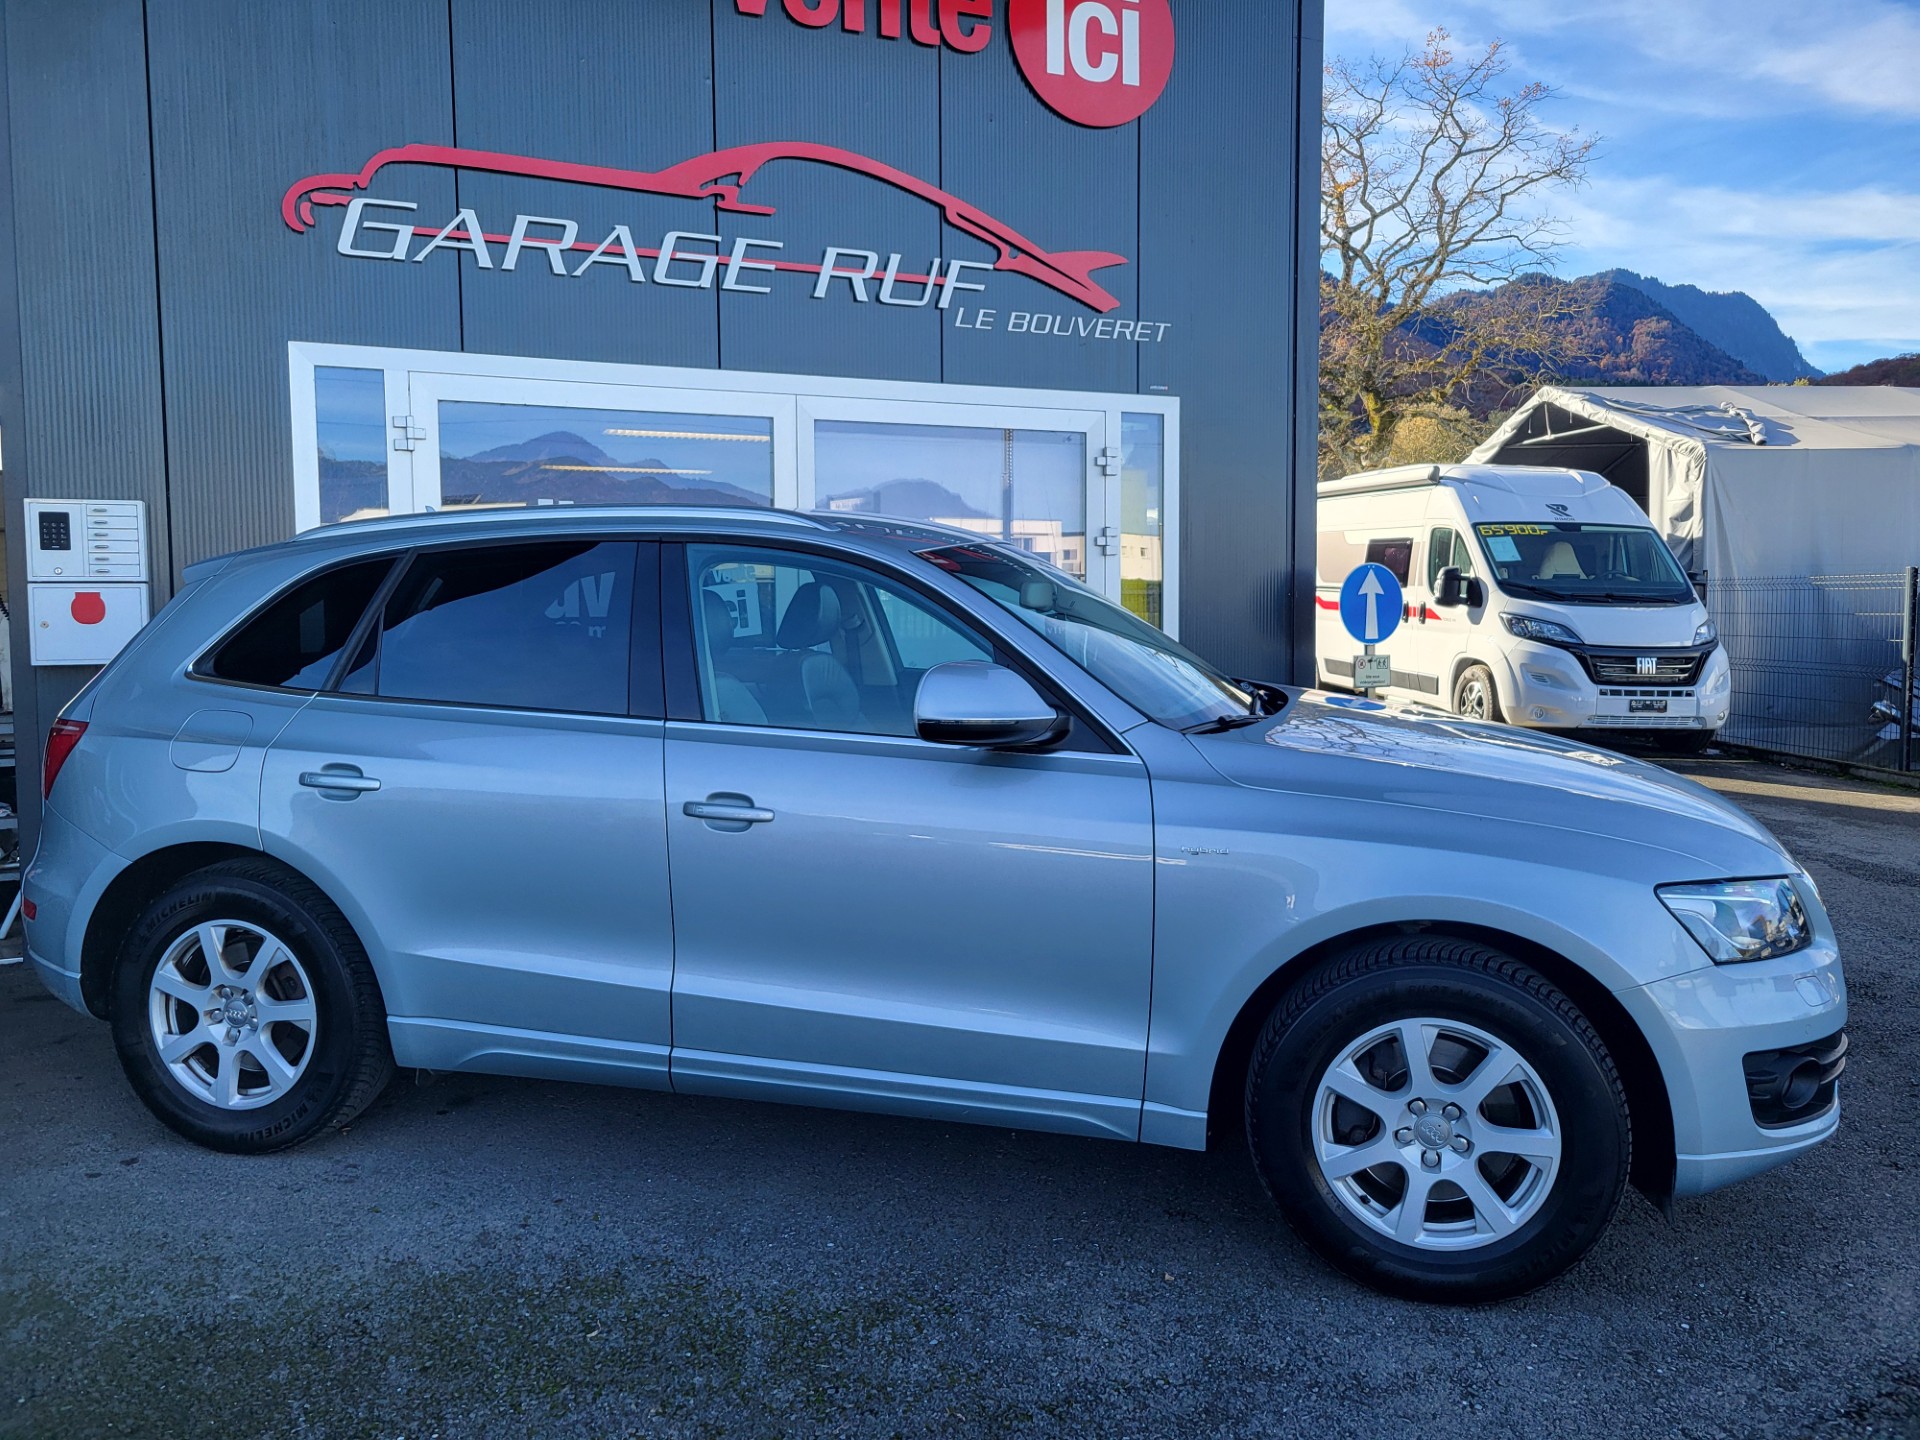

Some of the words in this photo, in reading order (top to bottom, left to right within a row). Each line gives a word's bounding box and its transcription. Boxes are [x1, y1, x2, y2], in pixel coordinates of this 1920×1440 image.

[1046, 0, 1140, 86] ici
[337, 197, 784, 293] GARAGE
[813, 246, 995, 310] RUF
[954, 307, 997, 331] LE
[1007, 311, 1172, 343] BOUVERET
[1636, 657, 1657, 675] FIAT
[1181, 846, 1230, 856] hybrid
